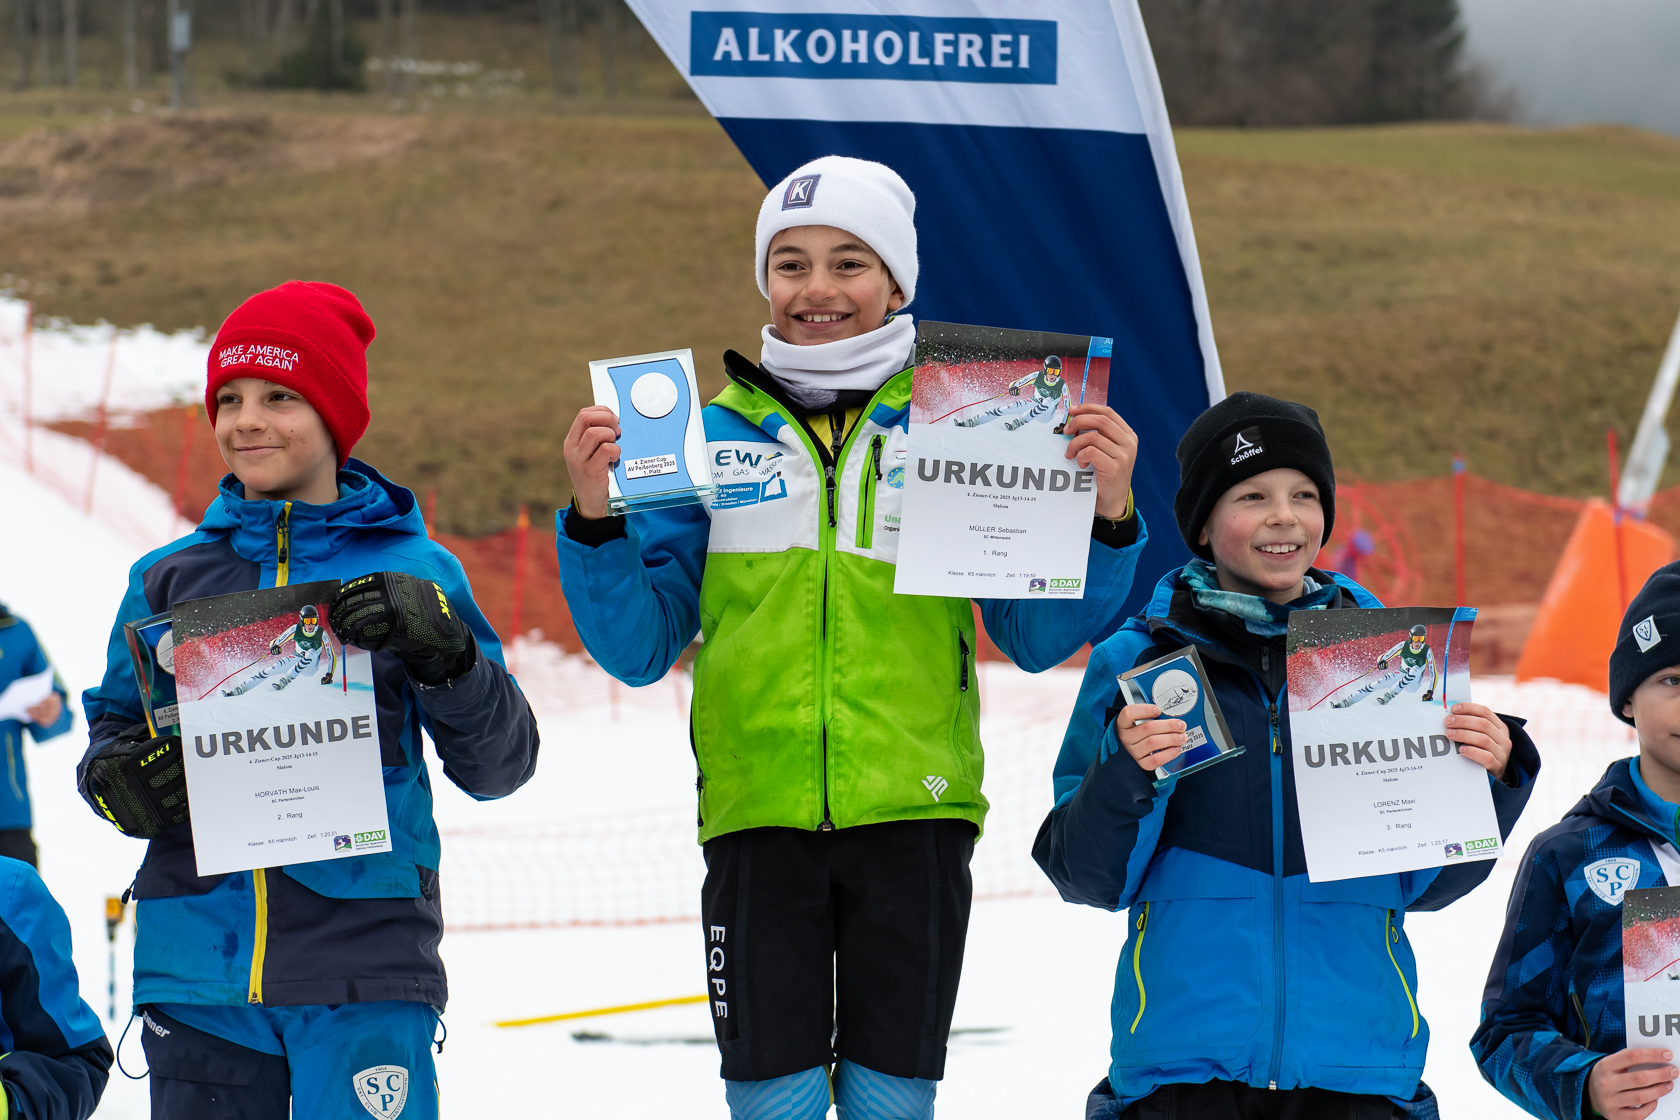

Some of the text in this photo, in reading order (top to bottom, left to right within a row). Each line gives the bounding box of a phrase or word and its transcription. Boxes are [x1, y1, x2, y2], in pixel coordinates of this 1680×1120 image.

[712, 27, 1030, 68] ALKOHOLFREI
[793, 180, 807, 200] K
[219, 344, 299, 363] MAKE AMERICA
[220, 354, 293, 371] GREAT AGAIN
[1230, 446, 1263, 465] Schöffel
[635, 463, 663, 471] Peißenberg
[759, 458, 783, 476] WASSER
[917, 458, 1094, 493] URKUNDE
[972, 492, 999, 500] Ziener-Cup
[340, 576, 373, 594] LEKI
[1059, 579, 1080, 587] DAV
[194, 714, 372, 759] URKUNDE
[140, 743, 170, 767] LEKI
[254, 756, 281, 764] Ziener-Cup
[255, 785, 320, 798] HORVATH Max-Louis
[1373, 800, 1400, 808] LORENZ
[276, 836, 297, 844] männlich
[364, 831, 384, 842] DAV
[1475, 839, 1496, 849] DAV
[708, 925, 728, 1018] EQPE
